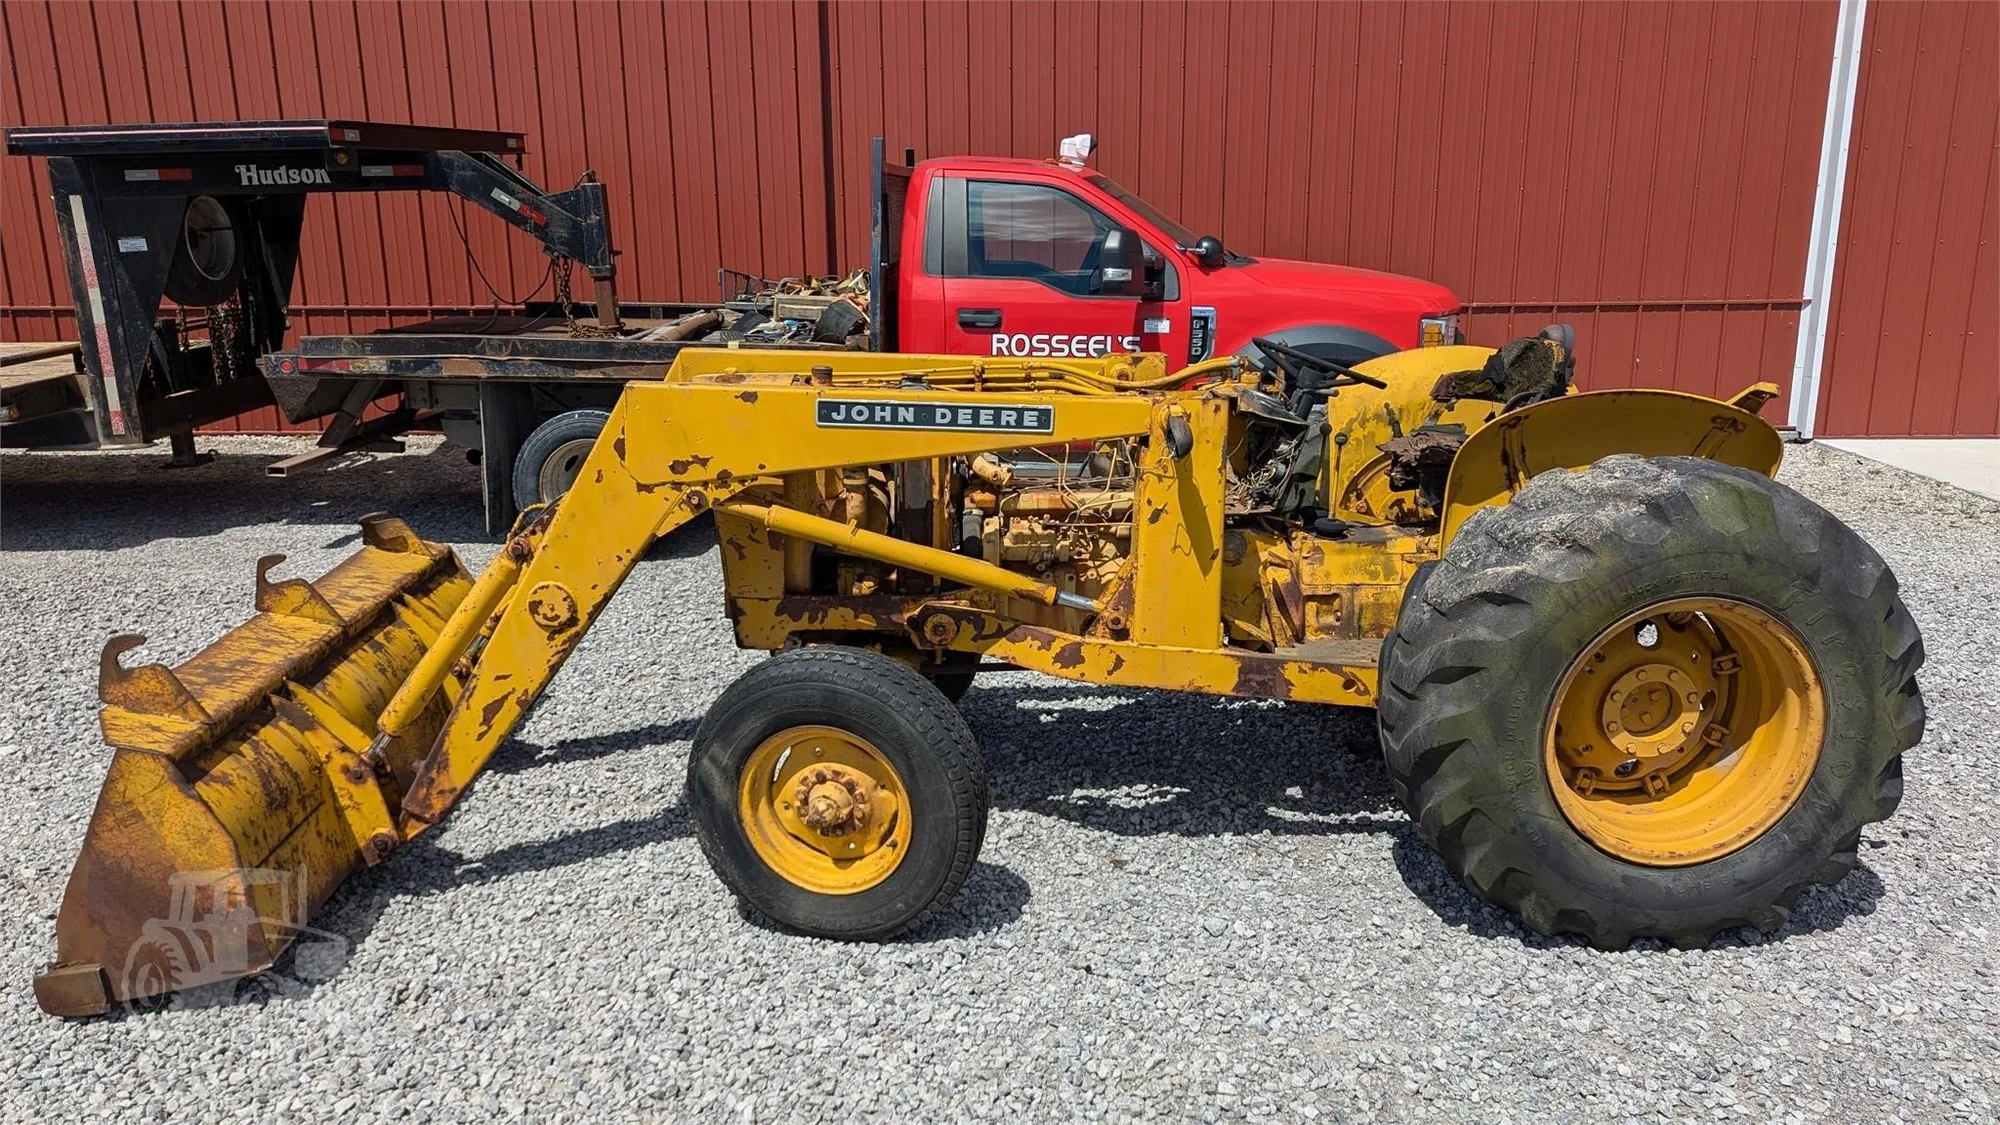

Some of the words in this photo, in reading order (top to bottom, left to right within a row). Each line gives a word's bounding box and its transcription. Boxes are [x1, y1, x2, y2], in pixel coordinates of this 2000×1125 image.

[234, 164, 331, 186] Hudson
[992, 333, 1142, 357] ROSSEEL'S
[831, 404, 915, 423] JOHN
[935, 407, 1039, 427] DEERE
[1778, 578, 1868, 845] Fireston
